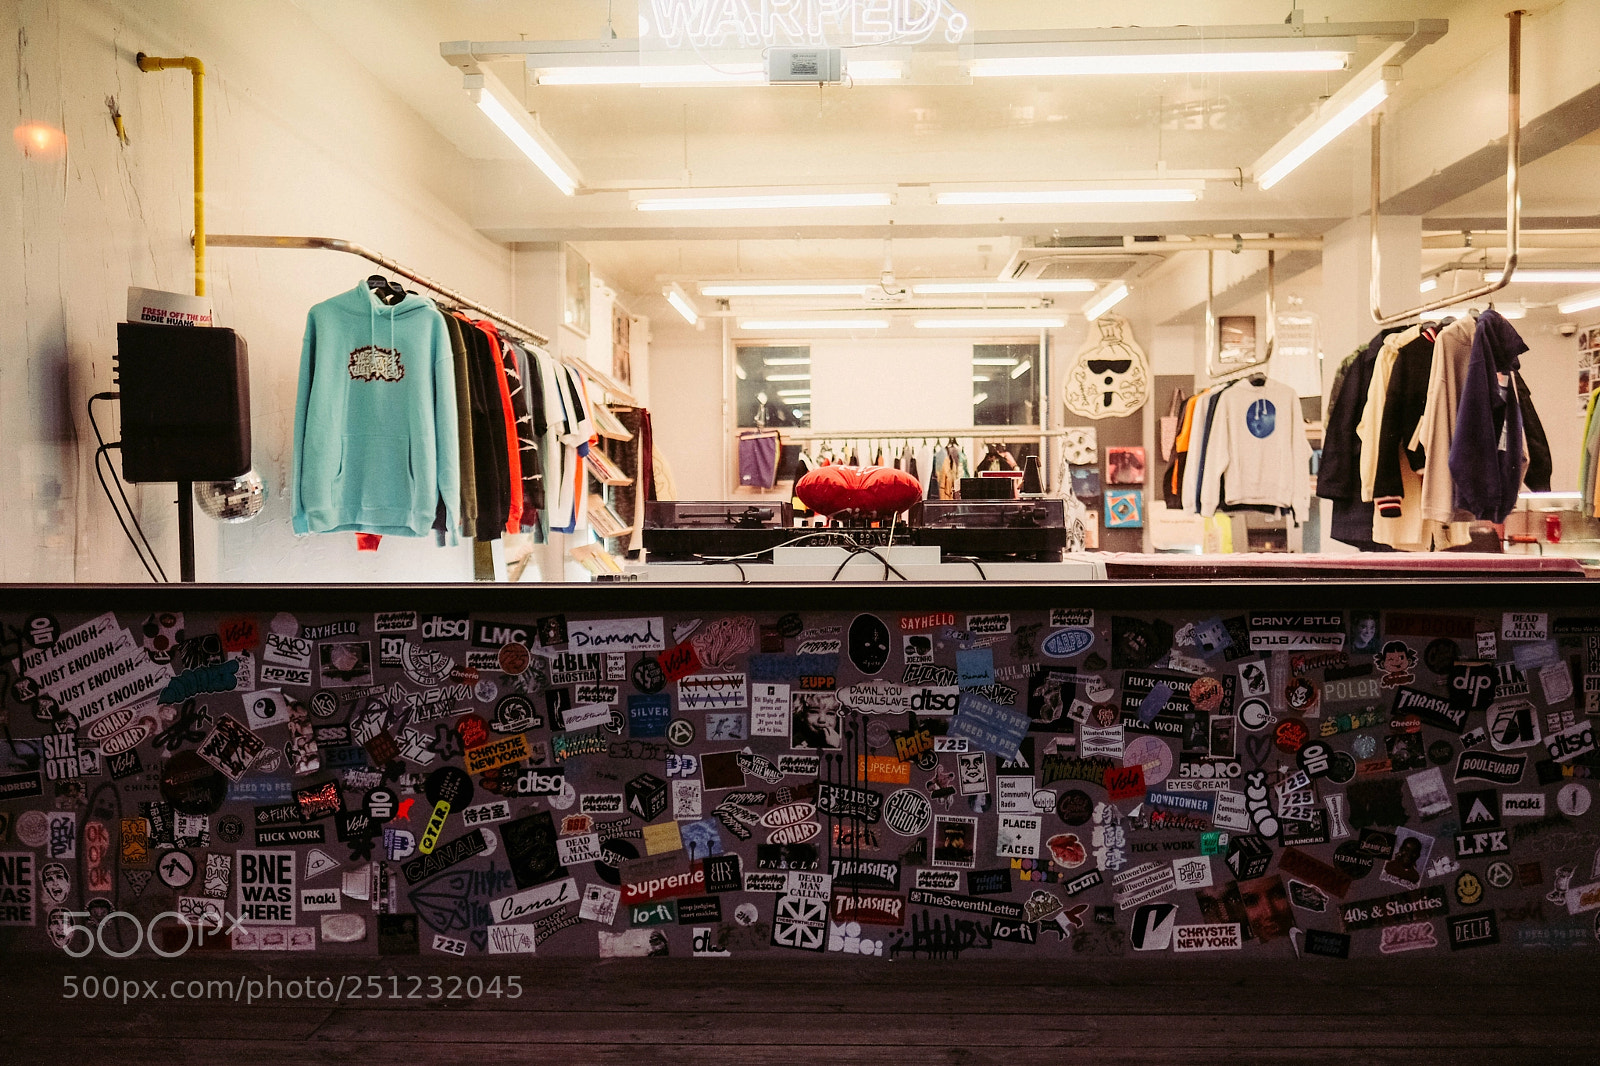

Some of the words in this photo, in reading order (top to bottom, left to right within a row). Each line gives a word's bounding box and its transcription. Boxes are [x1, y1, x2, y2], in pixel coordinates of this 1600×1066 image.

[141, 314, 164, 324] EDDIE
[142, 307, 168, 317] FRESH
[170, 311, 185, 320] OFF
[901, 614, 955, 629] SAYHELLO
[1512, 614, 1539, 622] DEAD
[304, 622, 356, 639] SAYHELLO
[480, 627, 528, 645] LMC
[572, 620, 660, 646] Diamond
[1504, 631, 1545, 639] CALLING
[52, 624, 98, 659] ENOUGH
[38, 666, 66, 689] JUST
[69, 642, 114, 674] ENOUGH
[58, 683, 85, 706] JUST
[89, 658, 135, 690] ENOUGH
[552, 670, 598, 683] GHOSTRA
[680, 675, 744, 692] KNOW
[1128, 677, 1155, 687] FUCK
[78, 699, 105, 722] JUST
[108, 674, 154, 707] ENOUGH
[682, 692, 742, 708] WAVE
[911, 689, 959, 715] dtsq
[630, 707, 669, 718] SILVER
[1398, 689, 1466, 727] THRASHER
[92, 710, 133, 737] CONART
[43, 733, 76, 759] SIZE
[103, 728, 146, 754] CONART
[937, 739, 967, 750] 725
[46, 758, 79, 780] OTR
[1179, 762, 1242, 778] 5BORO
[1462, 758, 1520, 775] BOULEVARD
[0, 781, 36, 792] NDREDS
[517, 771, 565, 794] dtsq
[1000, 781, 1015, 789] Seoul
[1000, 790, 1031, 800] Community
[1151, 793, 1208, 811] DOWNTOWNER
[1281, 792, 1311, 805] 725
[891, 791, 929, 819] STONES
[1506, 798, 1540, 809] maki
[767, 806, 810, 824] CONART
[890, 806, 924, 834] THROW
[1281, 807, 1311, 819] 725
[596, 818, 631, 830] FOLLOW
[1002, 819, 1037, 830] PLACES
[260, 832, 285, 842] FUCK
[289, 830, 320, 839] WORK
[599, 830, 641, 841] OVEMENT
[773, 824, 816, 843] CONART
[566, 837, 590, 847] DEAD
[570, 845, 589, 854] MAN
[1002, 844, 1034, 855] FACES
[1131, 842, 1158, 852] FUCK
[1162, 841, 1195, 850] WORK
[562, 851, 600, 863] CALLING
[0, 856, 31, 885] NE
[241, 855, 291, 884] BNE
[627, 870, 705, 898] Supreme
[798, 874, 823, 883] DEAD
[800, 882, 820, 890] MAN
[0, 888, 31, 903] AS
[242, 887, 291, 902] WAS
[304, 893, 337, 904] maki
[790, 888, 828, 899] CALLING
[500, 883, 568, 920] Canal
[923, 892, 1021, 917] TheSeventhLetter
[242, 905, 291, 920] HERE
[633, 904, 673, 923] lo-fi
[1344, 908, 1368, 923] 40s
[1371, 906, 1383, 917] &
[1386, 896, 1442, 916] Shorties
[993, 922, 1033, 942] lo-fi
[1178, 927, 1236, 938] CHRYSTIE
[436, 937, 465, 954] 725
[1177, 938, 1205, 948] NEW
[1207, 937, 1238, 947] YORK
